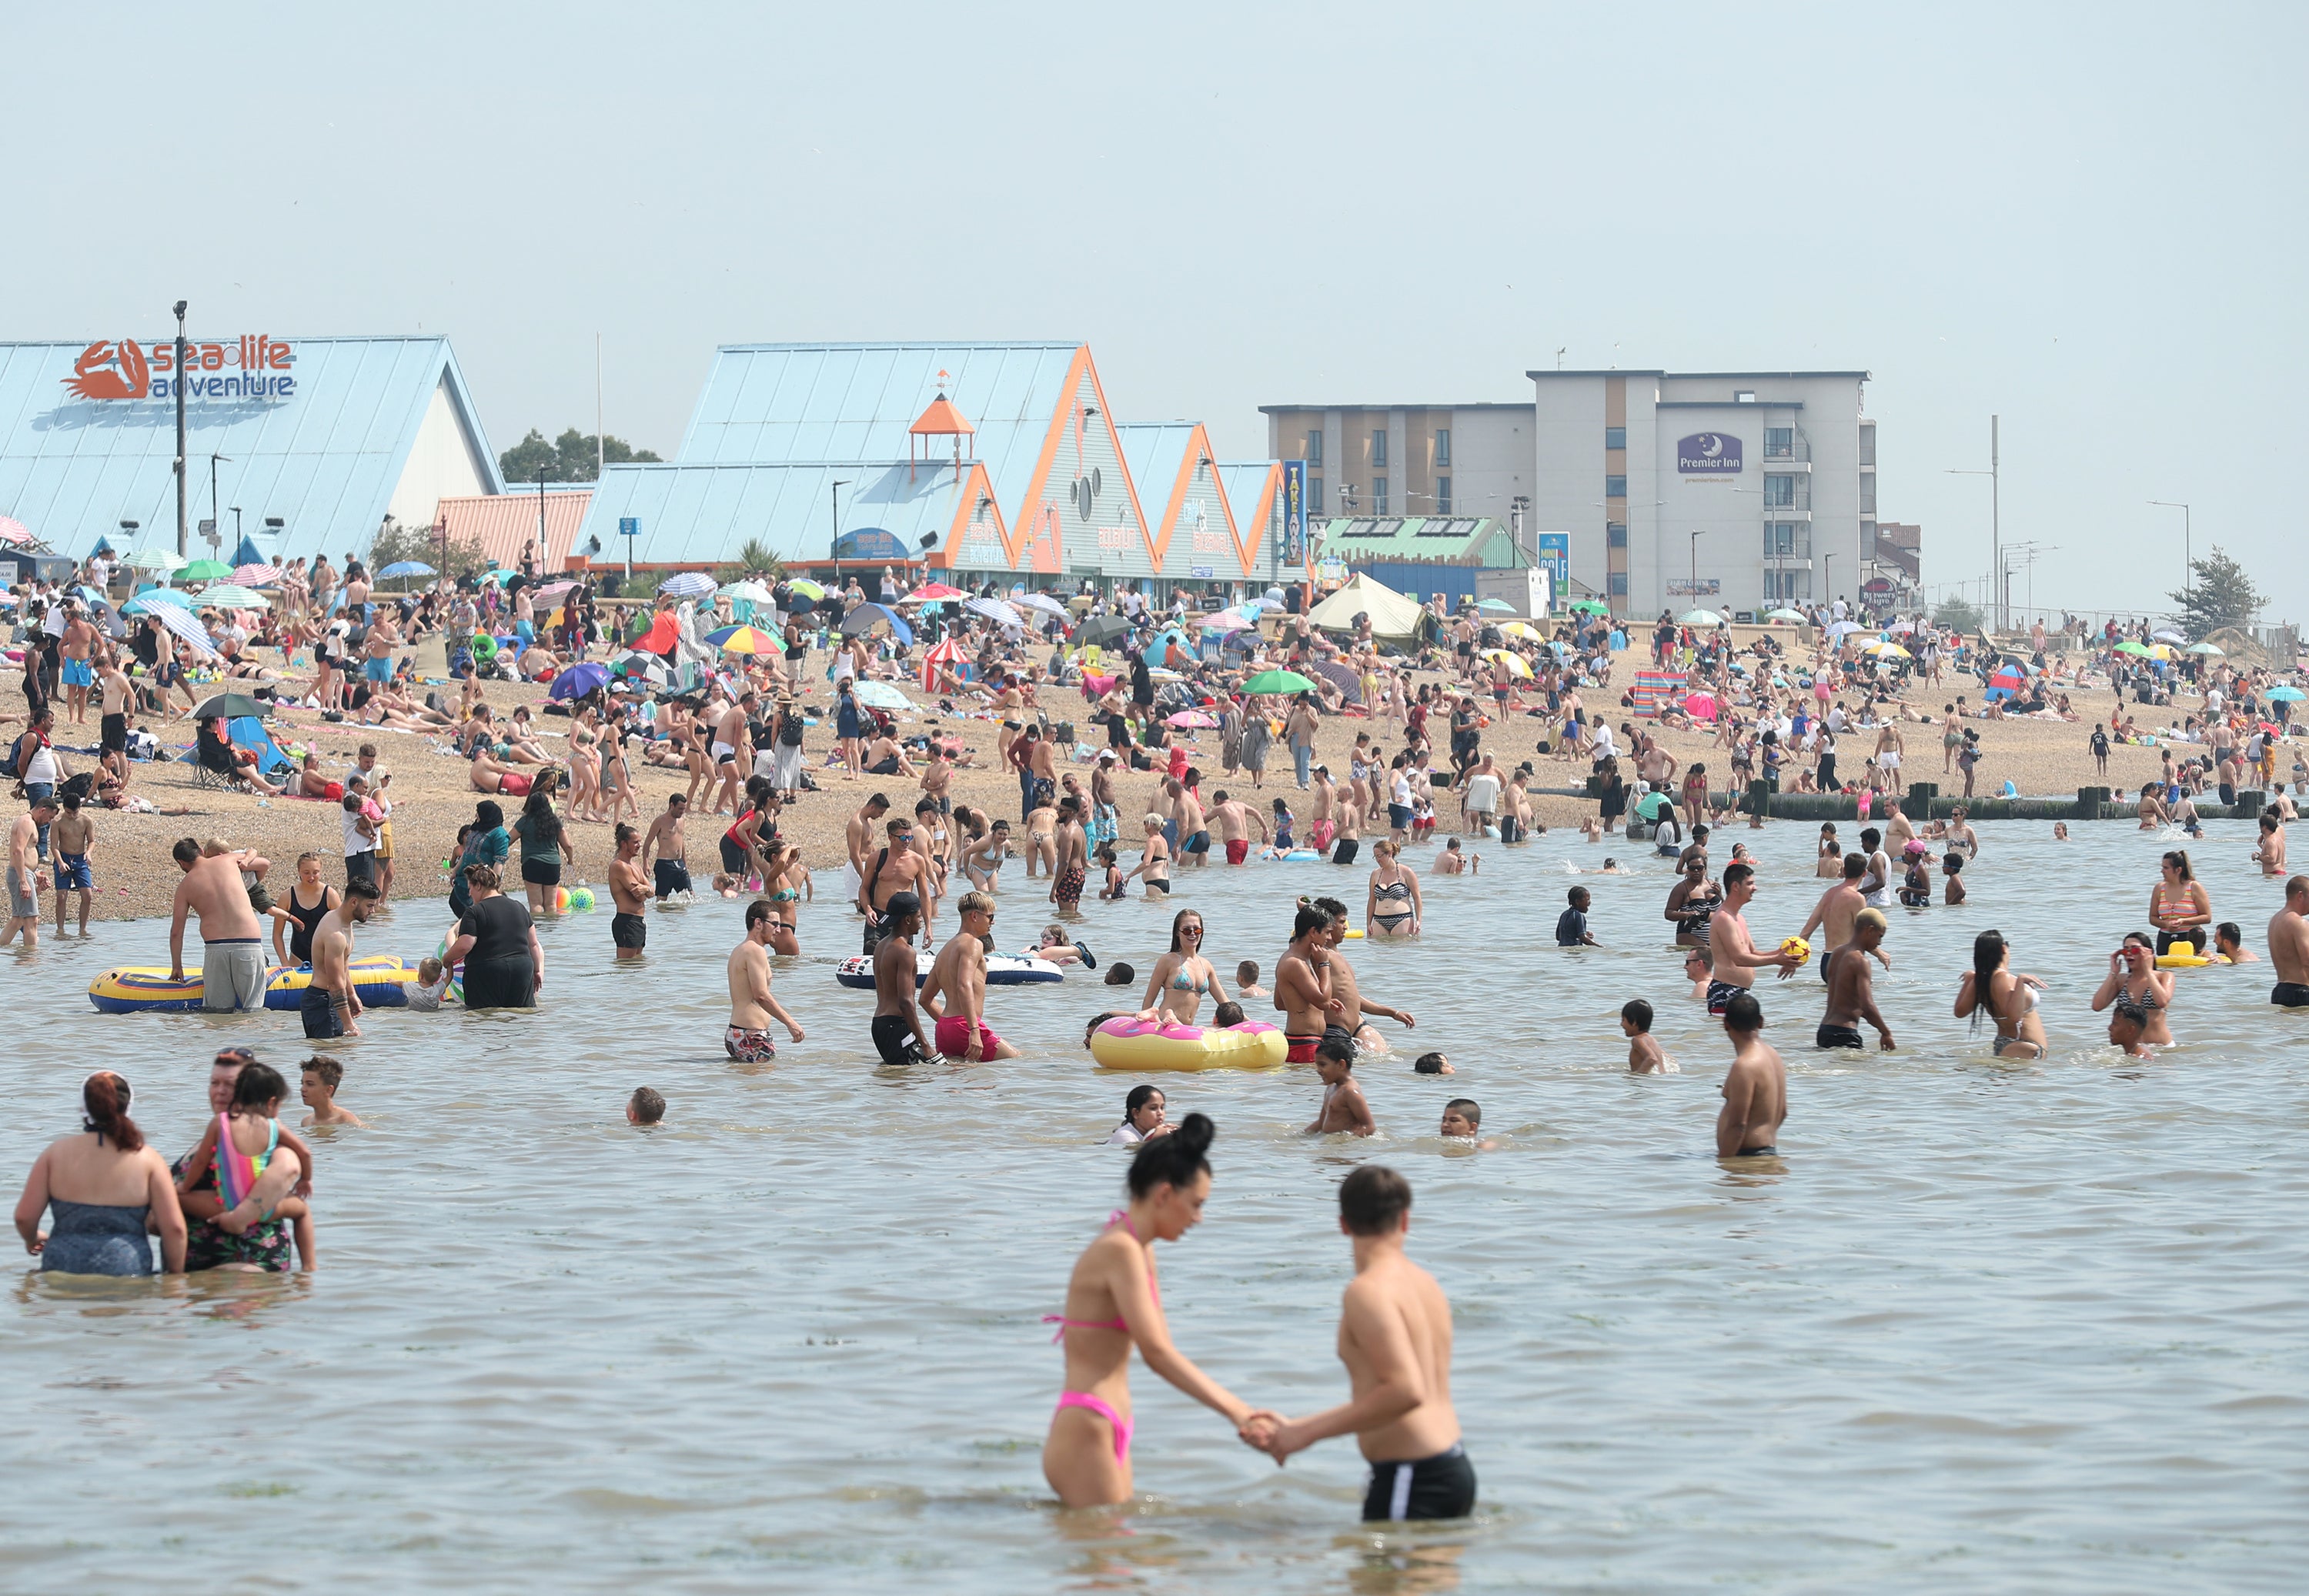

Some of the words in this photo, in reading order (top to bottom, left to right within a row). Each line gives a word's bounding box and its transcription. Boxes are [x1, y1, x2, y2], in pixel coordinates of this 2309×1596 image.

[240, 334, 290, 370] life
[152, 371, 293, 397] adventure
[1680, 457, 1722, 468] Premier
[1724, 457, 1739, 467] Inn
[1289, 467, 1299, 513] TAKE
[1098, 523, 1136, 555] aquarium
[1288, 513, 1300, 559] AWAY
[1541, 549, 1555, 559] MINI
